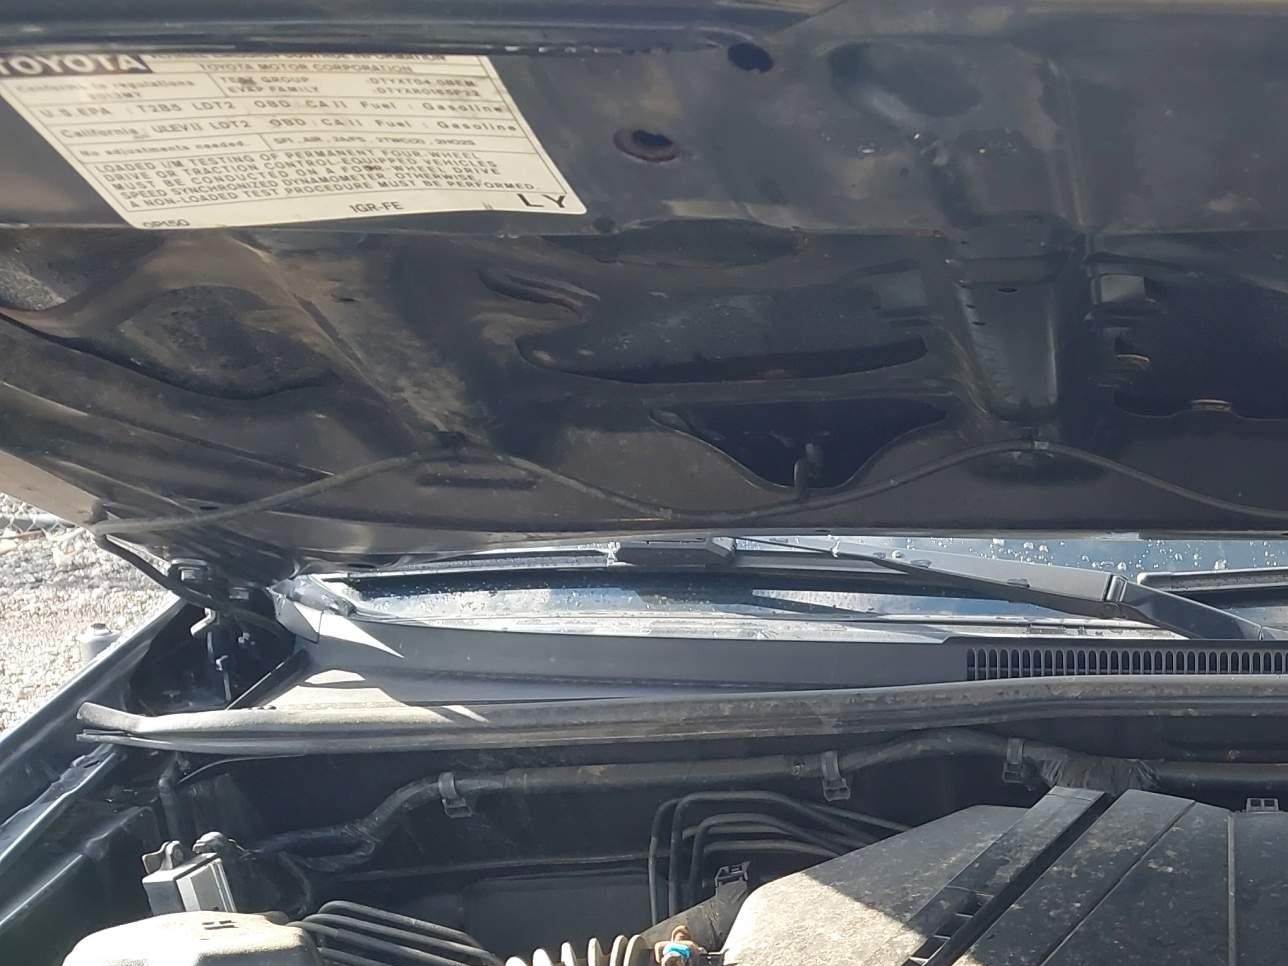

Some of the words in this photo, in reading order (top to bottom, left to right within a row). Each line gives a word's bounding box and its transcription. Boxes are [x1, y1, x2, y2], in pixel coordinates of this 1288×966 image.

[0, 54, 147, 76] TOYOTA
[200, 63, 254, 71] TOYOTA
[257, 63, 308, 71] MOTOR
[312, 63, 414, 73] CORPORATION
[260, 76, 310, 84] GROUP
[269, 86, 319, 94] FAMILY
[192, 100, 237, 112] LDT2
[254, 100, 292, 109] OBD
[359, 101, 397, 110] Fuel
[422, 102, 503, 113] Gasoline
[208, 119, 253, 130] LDT2
[269, 118, 308, 127] OBD
[374, 119, 412, 128] Fuel
[436, 121, 518, 132] Gasoline
[94, 162, 157, 173] LOADED
[161, 159, 184, 169] I/M
[190, 155, 256, 167] TESTING
[259, 153, 280, 162] OF
[285, 150, 376, 159] PERMANENT
[103, 172, 151, 183] DRIVE
[155, 169, 178, 179] OR
[184, 164, 259, 178] TRACTION
[423, 158, 498, 168] VEHICLES
[111, 181, 155, 191] MUST
[163, 178, 186, 188] BE
[190, 170, 290, 185] CONDUCTED
[295, 168, 319, 177] ON
[325, 166, 335, 175] A
[452, 166, 501, 176] DRIVE
[119, 188, 168, 201] SPEED
[170, 180, 279, 196] SYNCHRONIZED
[144, 192, 239, 207] NON-LOADED
[243, 188, 279, 199] TEST
[283, 181, 374, 195] PROCEDURE
[376, 179, 417, 189] MUST
[422, 179, 440, 187] BE
[348, 201, 405, 214] 1GR-FE
